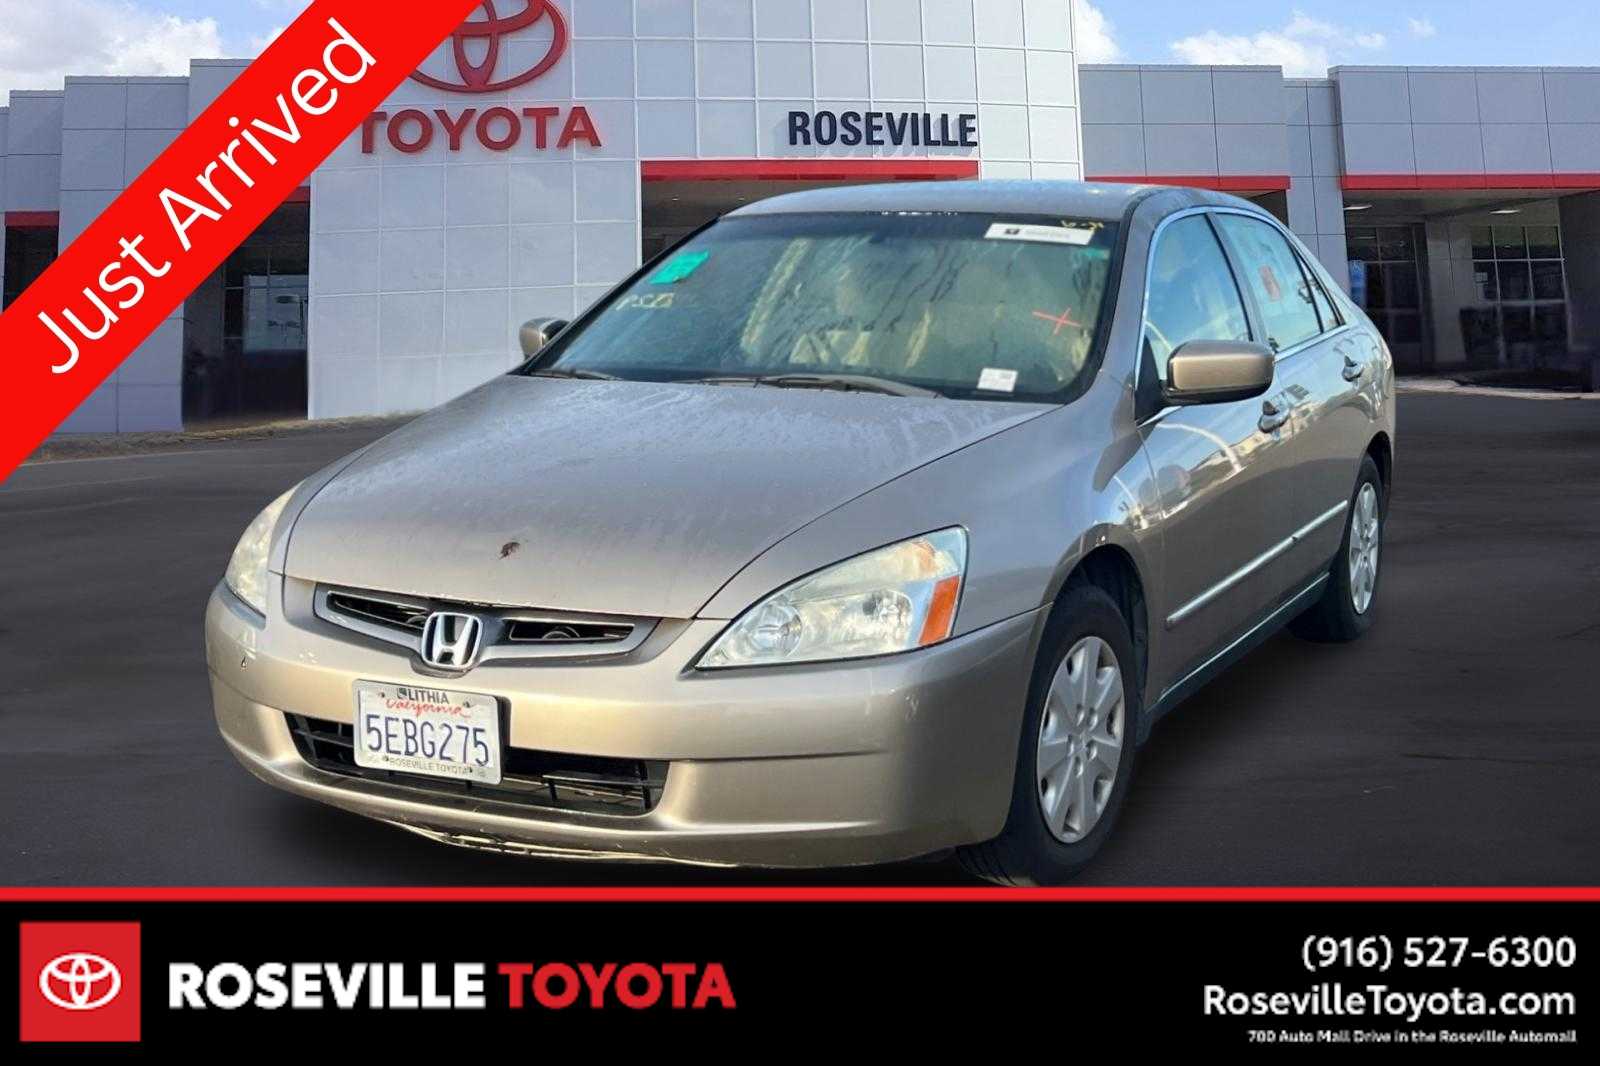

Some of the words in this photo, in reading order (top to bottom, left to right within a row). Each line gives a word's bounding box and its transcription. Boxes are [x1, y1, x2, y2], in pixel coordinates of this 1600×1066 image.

[361, 106, 602, 153] TOYOTA
[788, 111, 978, 148] ROSEVILLE
[407, 688, 450, 704] LITHIA
[366, 714, 490, 768] 5EBG275
[389, 759, 436, 772] ROSEVILLE
